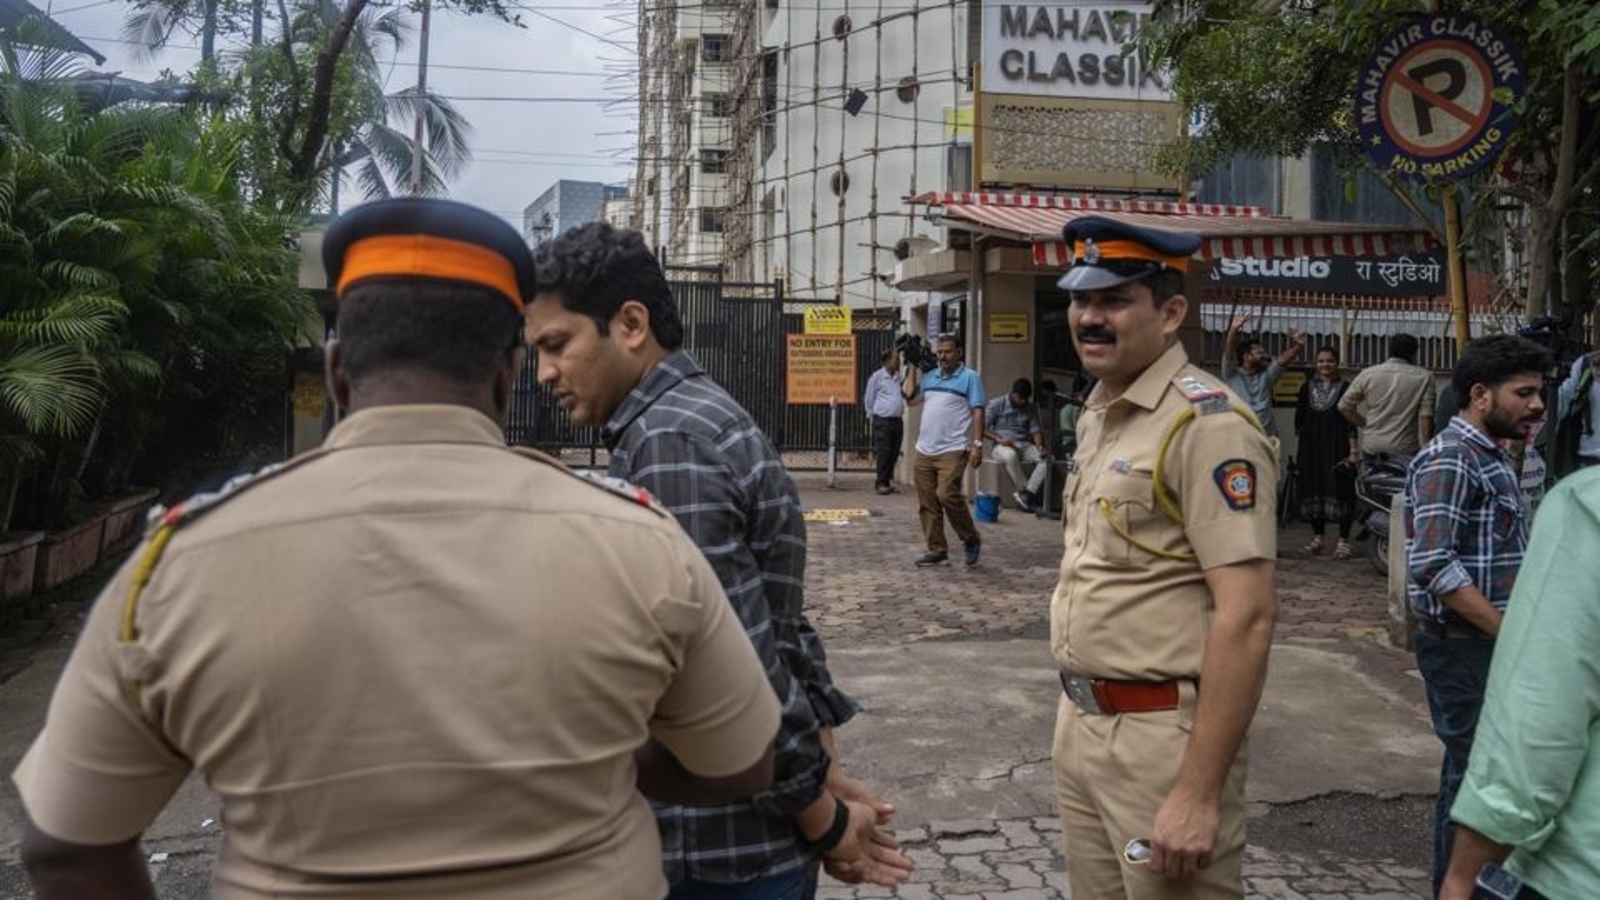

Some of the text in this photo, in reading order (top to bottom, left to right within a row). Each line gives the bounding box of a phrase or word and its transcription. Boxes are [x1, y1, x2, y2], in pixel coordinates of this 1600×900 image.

[1362, 18, 1518, 124] MAHAVIR CLASSIK
[1391, 154, 1416, 174] NO
[1355, 256, 1440, 287] रा स्टुडिओ
[790, 339, 852, 348] NO ENTRY FOR
